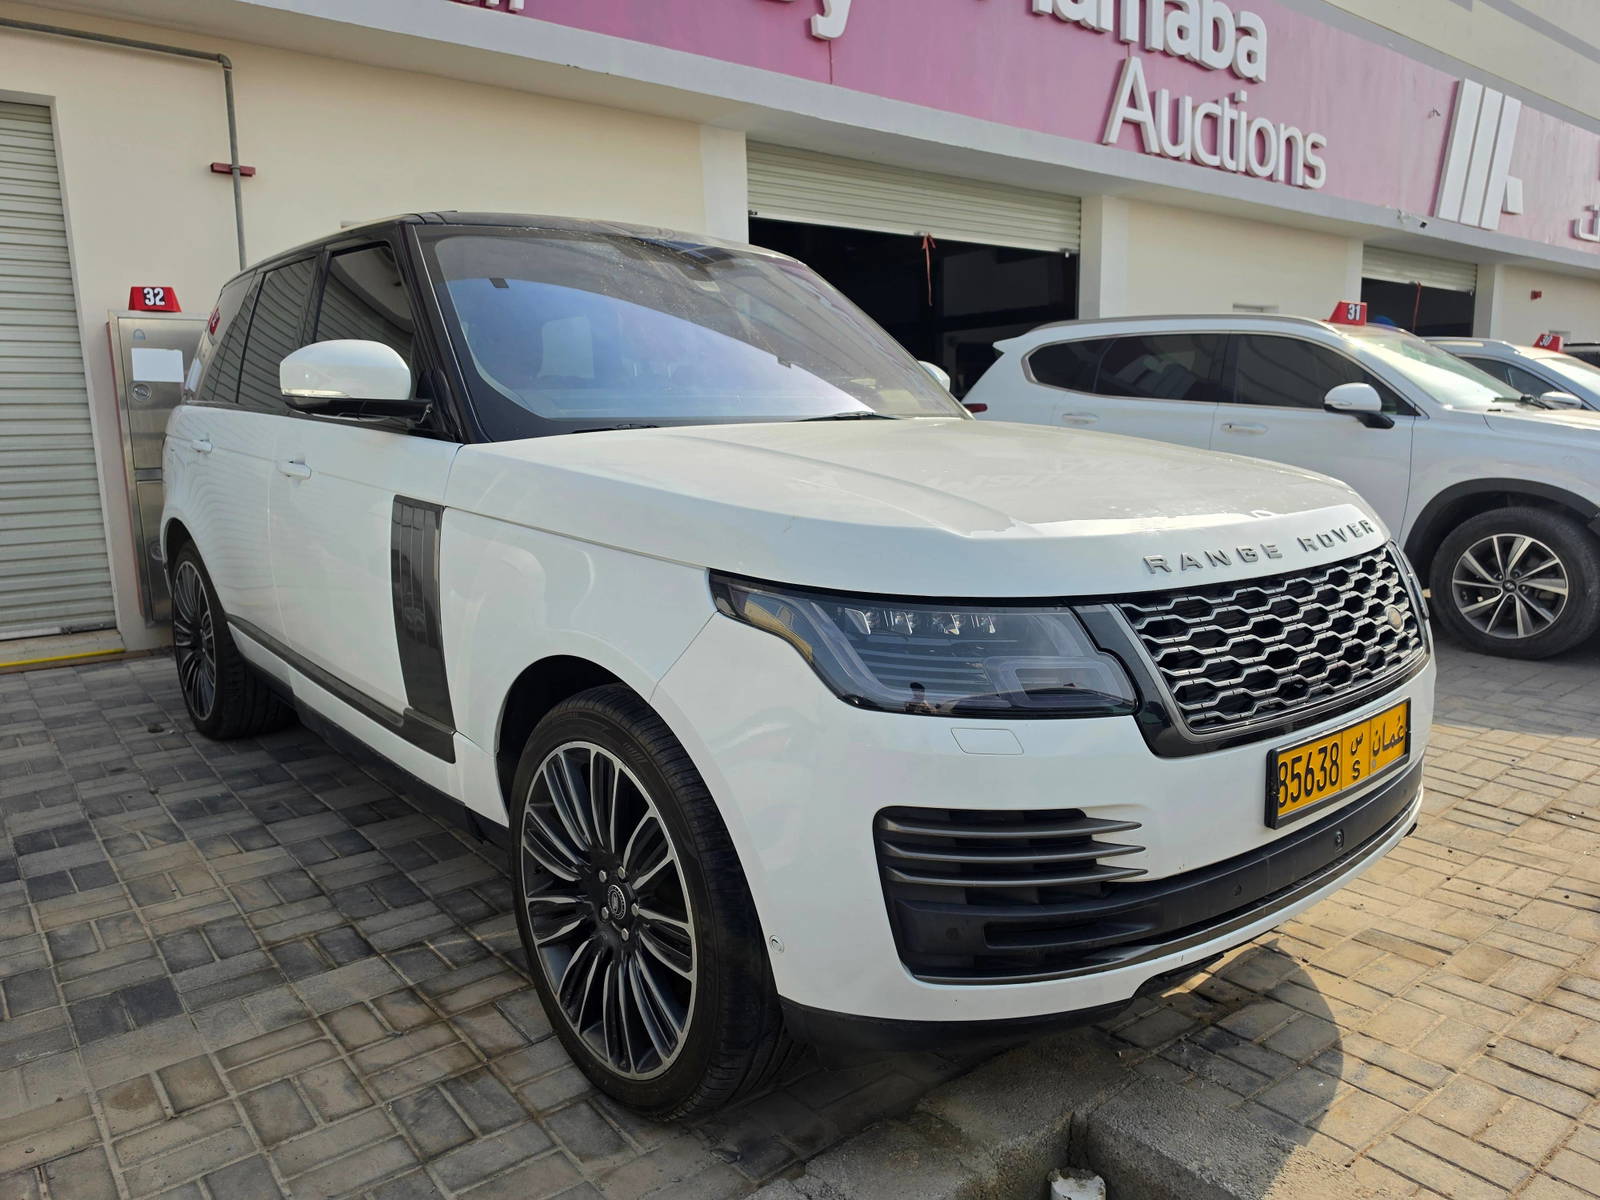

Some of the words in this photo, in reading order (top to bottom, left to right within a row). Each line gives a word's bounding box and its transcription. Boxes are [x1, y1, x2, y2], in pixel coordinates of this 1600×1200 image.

[1102, 56, 1328, 190] Auctions
[144, 288, 165, 305] 32
[1347, 304, 1360, 321] 31
[1143, 543, 1283, 574] RANGE
[1297, 519, 1375, 552] ROVER
[1350, 731, 1364, 757] س
[1278, 741, 1340, 809] 85638
[1351, 759, 1361, 781] S
